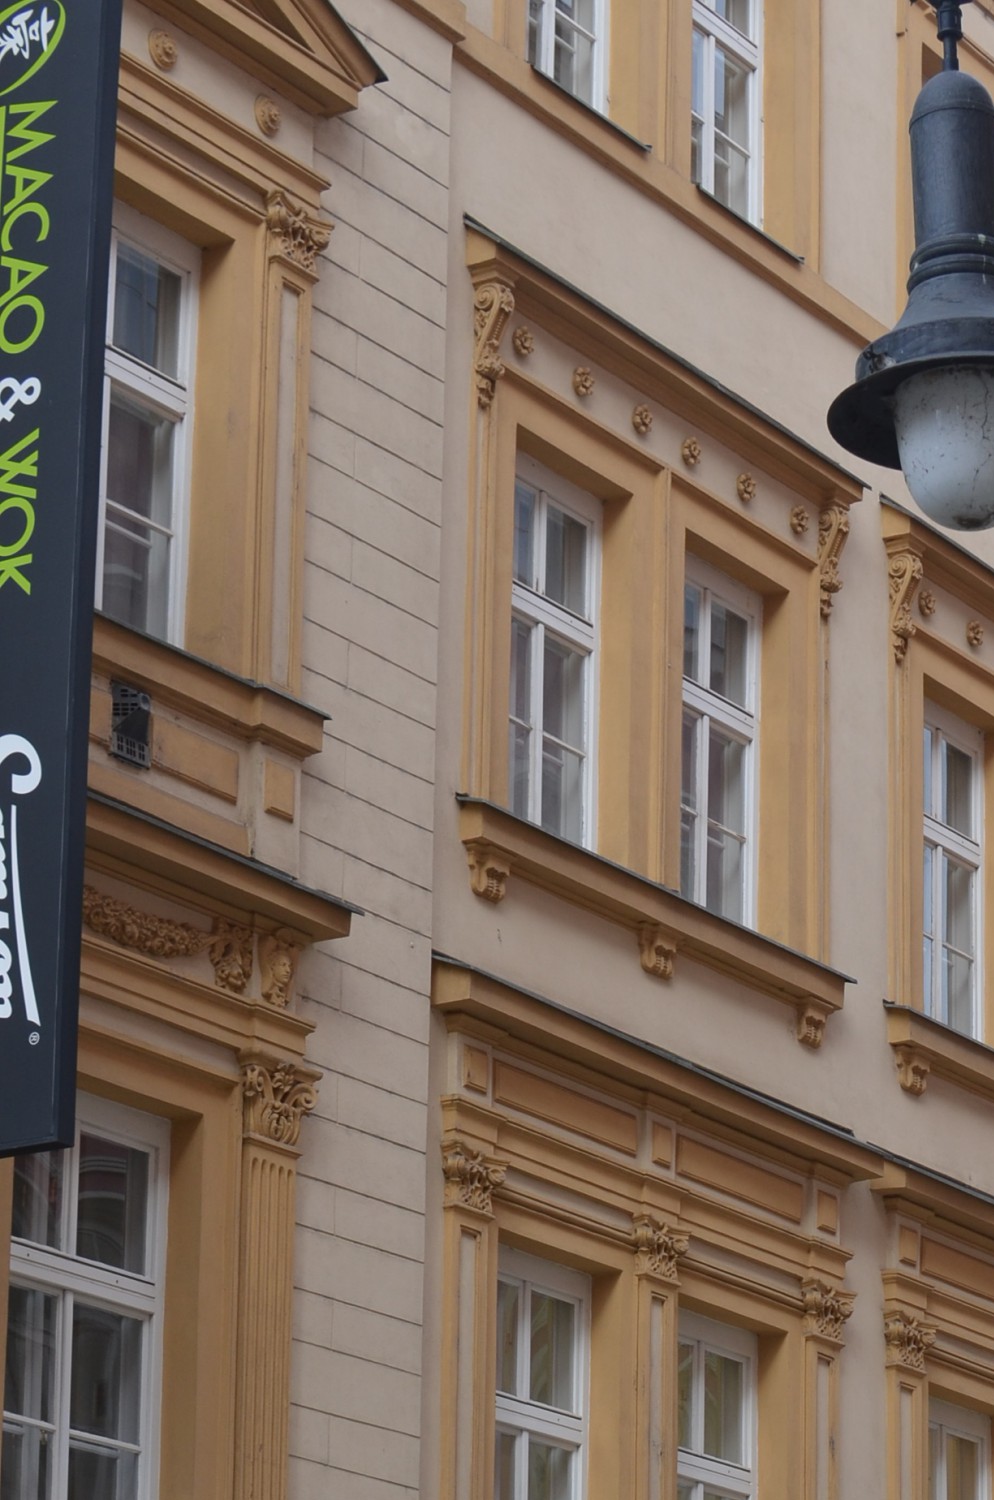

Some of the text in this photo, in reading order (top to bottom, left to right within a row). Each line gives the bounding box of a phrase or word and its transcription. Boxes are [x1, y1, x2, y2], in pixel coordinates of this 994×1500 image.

[0, 100, 58, 597] MACAO & WOK
